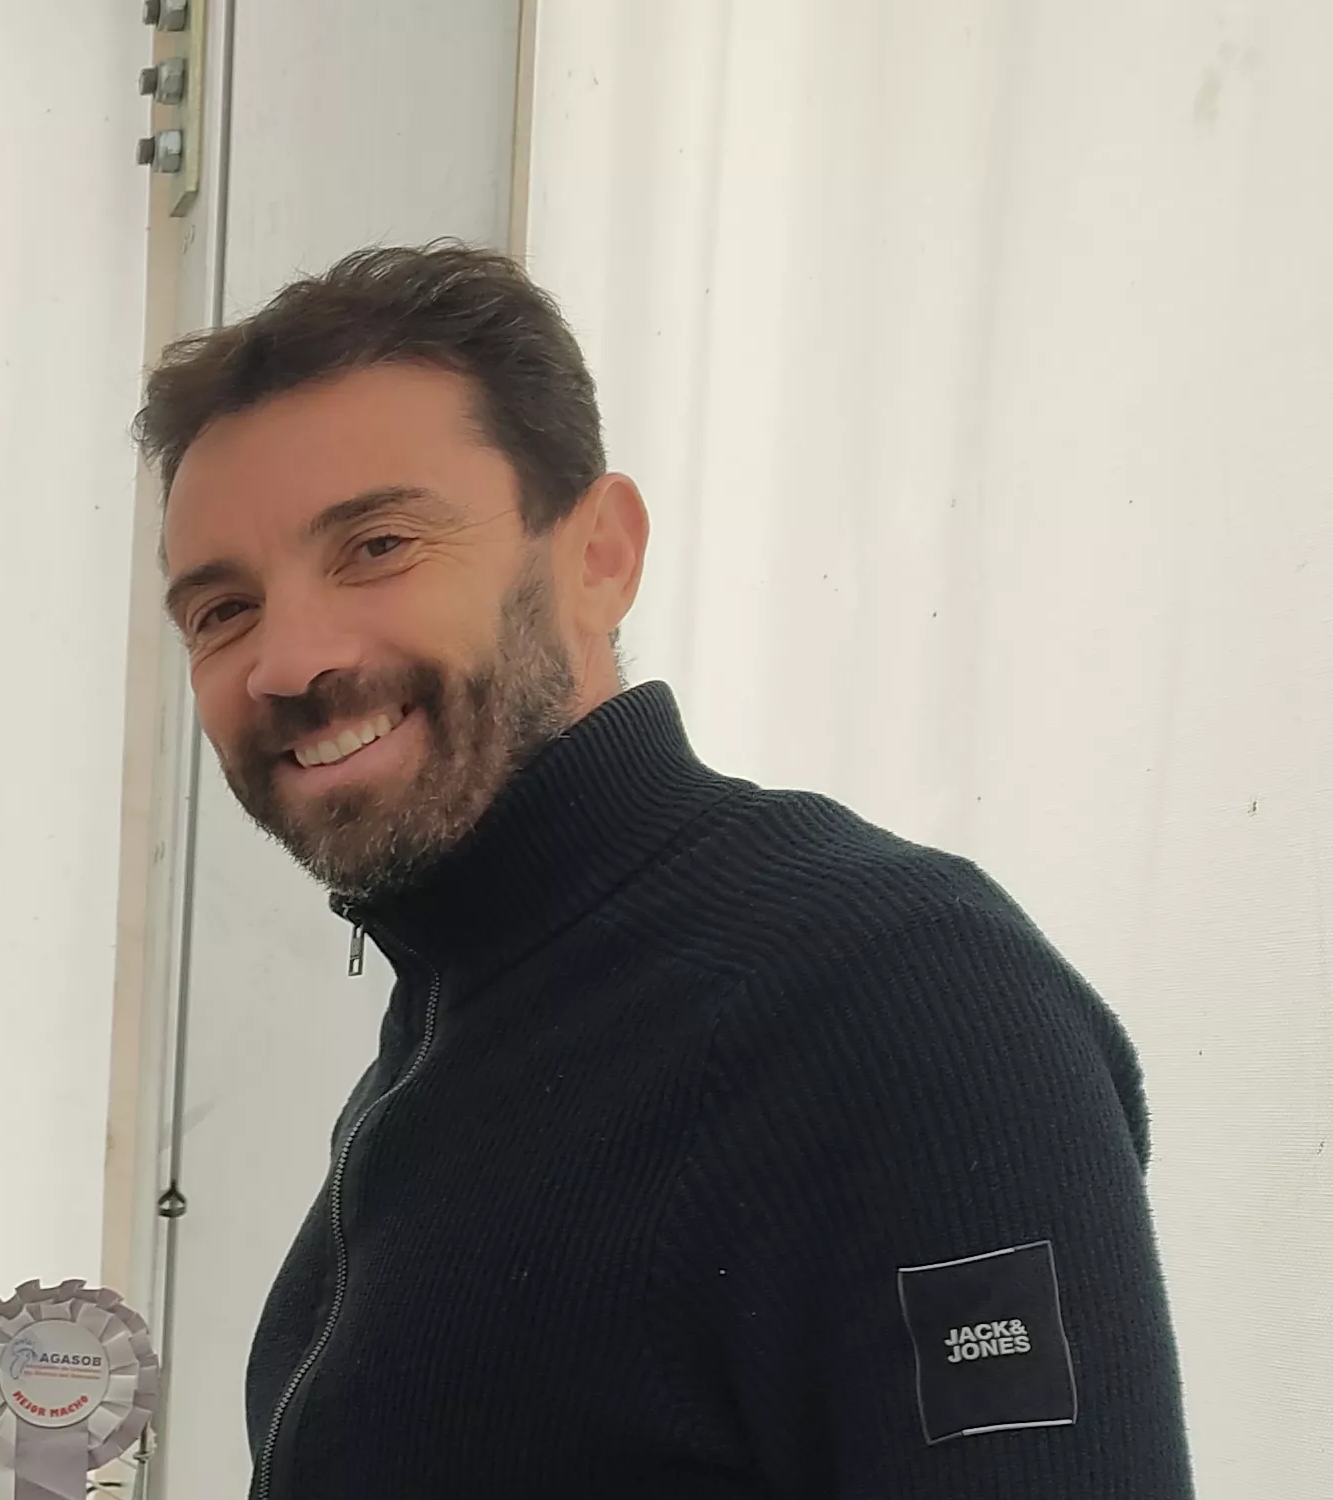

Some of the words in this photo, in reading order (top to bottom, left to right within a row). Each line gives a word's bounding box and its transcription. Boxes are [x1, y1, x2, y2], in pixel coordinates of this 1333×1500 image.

[944, 1319, 1028, 1346] JACK&
[40, 1352, 102, 1367] AGASOB
[947, 1335, 1031, 1363] JONES
[13, 1390, 46, 1416] MEJOR
[49, 1395, 89, 1418] MACHO
